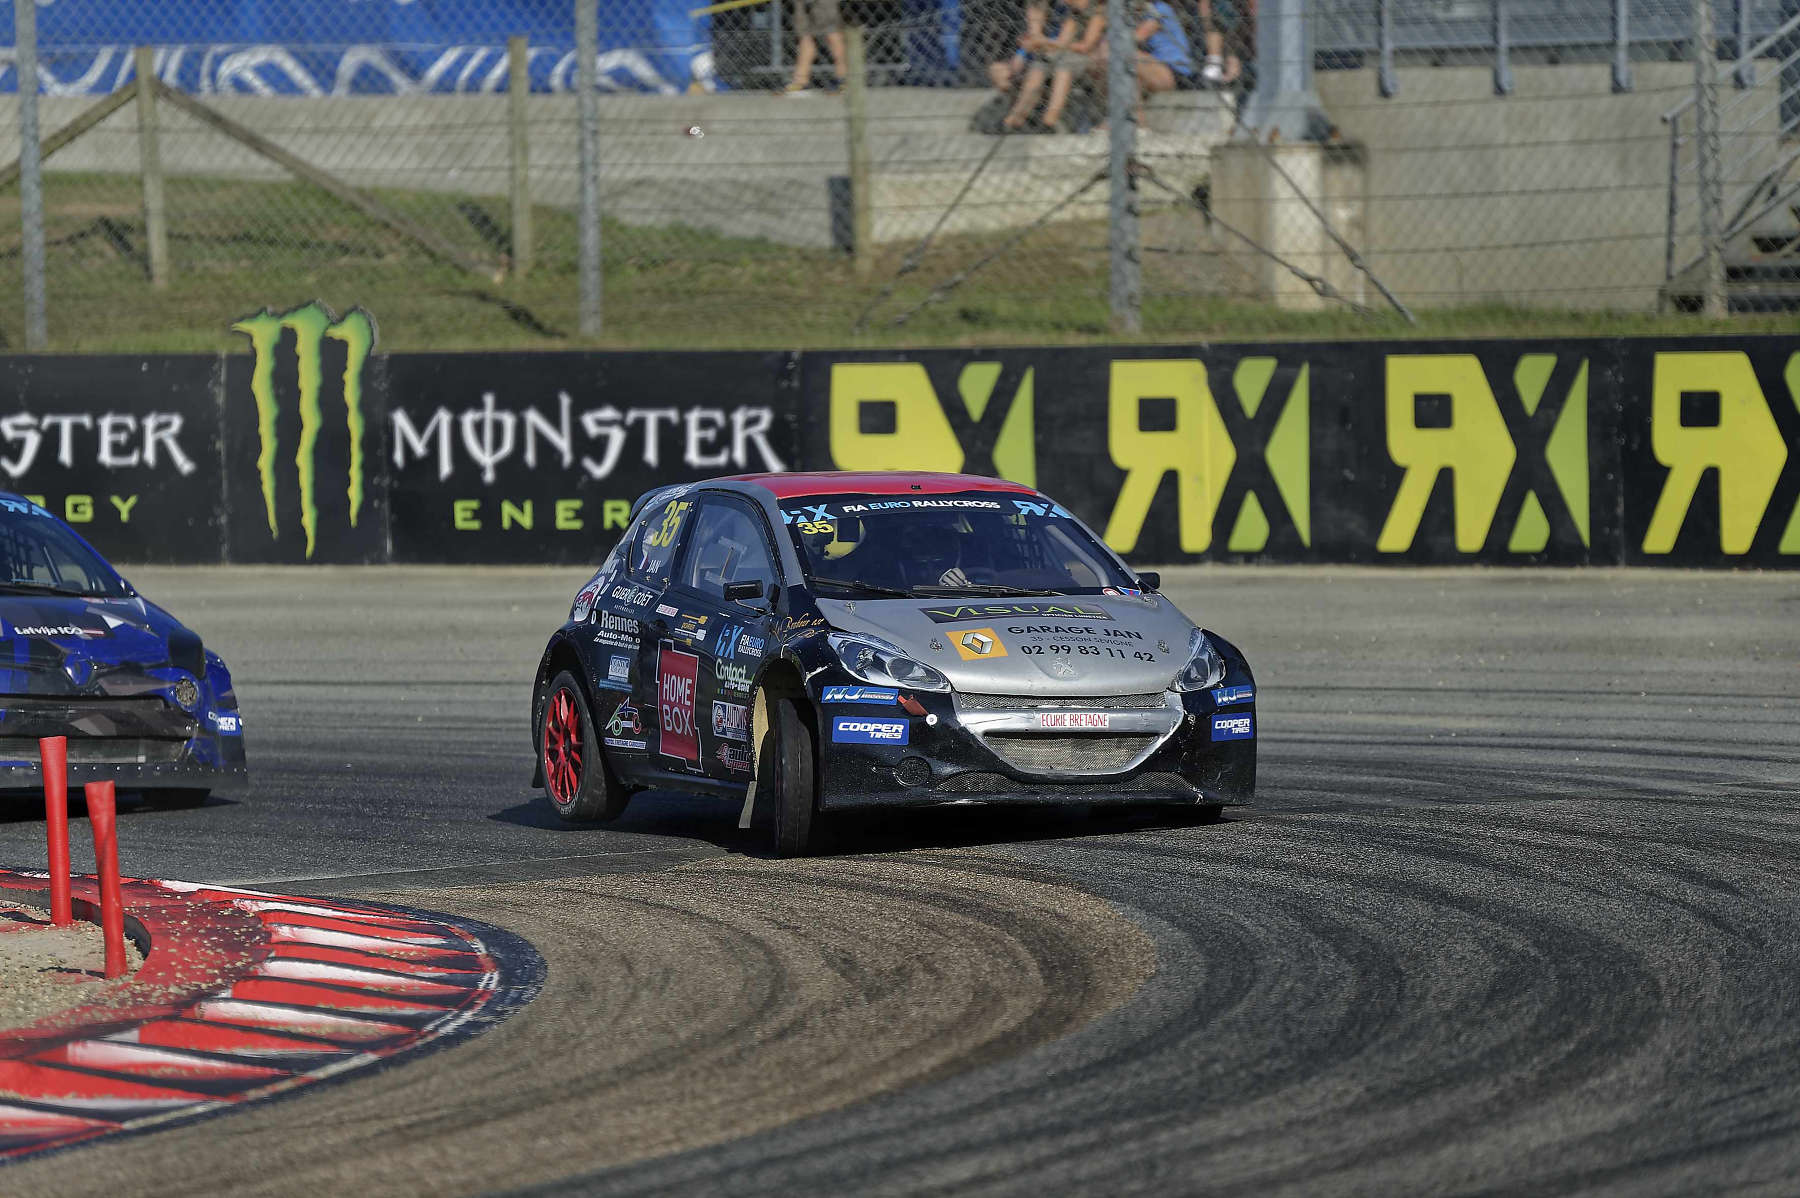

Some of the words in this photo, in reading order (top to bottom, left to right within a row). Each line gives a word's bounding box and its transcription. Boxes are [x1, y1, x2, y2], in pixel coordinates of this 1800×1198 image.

[391, 391, 787, 484] MONSTER
[1641, 350, 1800, 555] R
[452, 498, 632, 531] ENER
[842, 504, 869, 513] FIA
[868, 501, 911, 511] EURO
[912, 500, 1001, 509] RALLYCROSS
[651, 500, 689, 547] 35
[797, 520, 834, 535] 35
[601, 610, 640, 634] Rennes
[1007, 625, 1097, 635] GARAGE
[1103, 628, 1143, 640] JAN
[1021, 645, 1045, 655] 02
[1049, 644, 1072, 655] 99
[1077, 645, 1101, 656] 83
[1105, 647, 1126, 659] 11
[1133, 651, 1156, 662] 42
[663, 672, 692, 706] HOME
[662, 704, 693, 737] BOX
[838, 722, 905, 733] COOPER
[1041, 713, 1067, 727] ECURIE
[1069, 713, 1108, 727] BRETAGNE
[1214, 718, 1250, 730] COOPER
[869, 731, 902, 739] TIRES
[1231, 726, 1250, 734] TIRES
